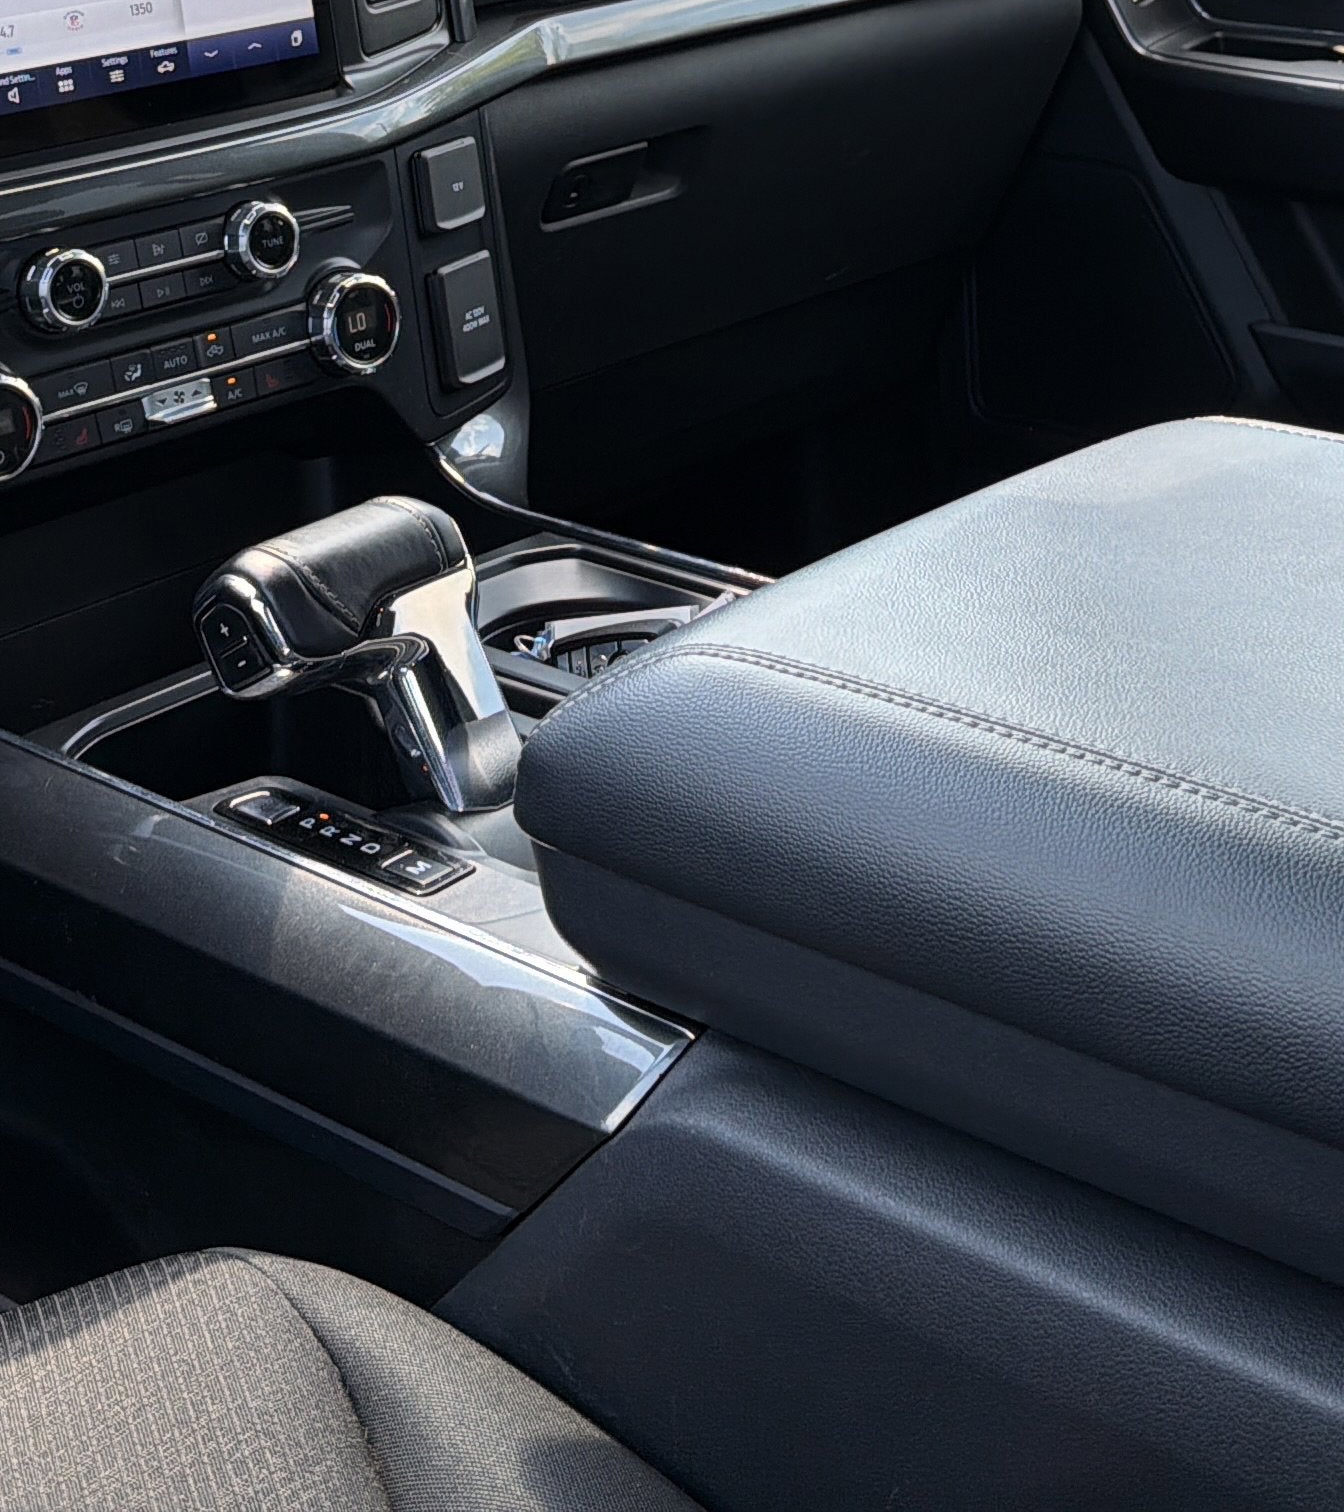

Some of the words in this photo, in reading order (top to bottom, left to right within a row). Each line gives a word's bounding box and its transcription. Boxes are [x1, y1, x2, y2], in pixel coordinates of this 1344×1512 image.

[130, 2, 153, 16] 1350
[101, 56, 128, 67] Settings
[56, 66, 72, 76] Apps
[262, 236, 284, 248] TUNE
[67, 283, 85, 294] VOL
[252, 331, 271, 343] MAX
[272, 327, 286, 338] A/C
[354, 338, 376, 351] DUAL
[164, 356, 188, 370] AUTO
[227, 388, 243, 400] A/C
[299, 817, 316, 829] P
[319, 825, 341, 838] R
[339, 833, 363, 846] N
[360, 842, 381, 854] D
[405, 860, 433, 875] M
